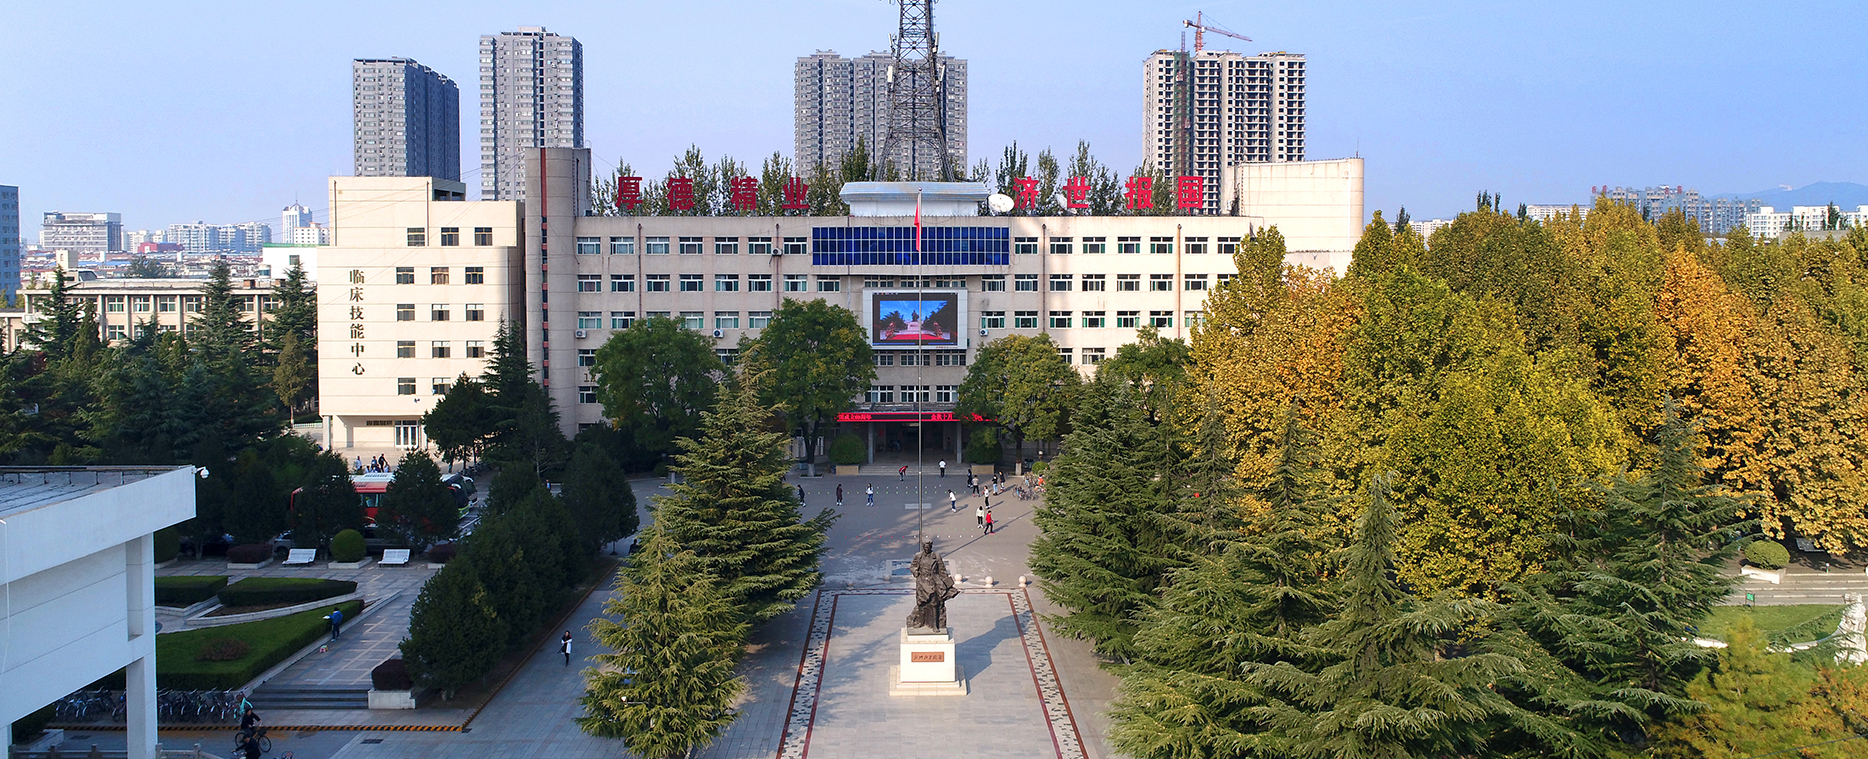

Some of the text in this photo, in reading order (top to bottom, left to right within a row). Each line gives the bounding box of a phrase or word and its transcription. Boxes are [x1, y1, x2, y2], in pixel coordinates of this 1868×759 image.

[615, 176, 1203, 210] 厚德精业 济世报国
[349, 269, 365, 376] 临床技能中心
